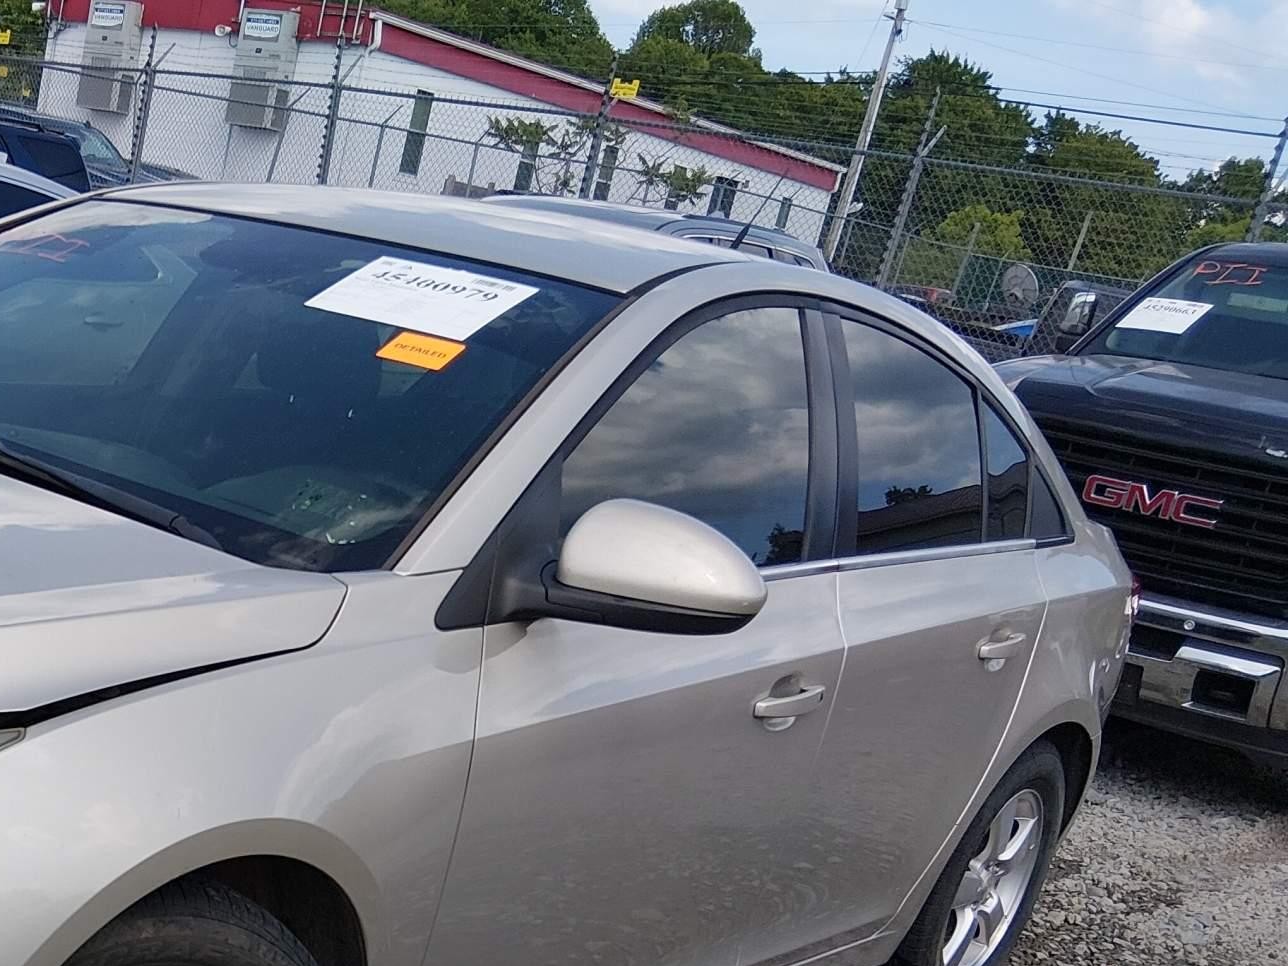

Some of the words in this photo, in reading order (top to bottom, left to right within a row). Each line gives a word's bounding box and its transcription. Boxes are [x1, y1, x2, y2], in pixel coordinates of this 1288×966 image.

[373, 270, 499, 302] 45400979
[394, 342, 448, 360] DETAILED
[1082, 474, 1224, 529] GMC
